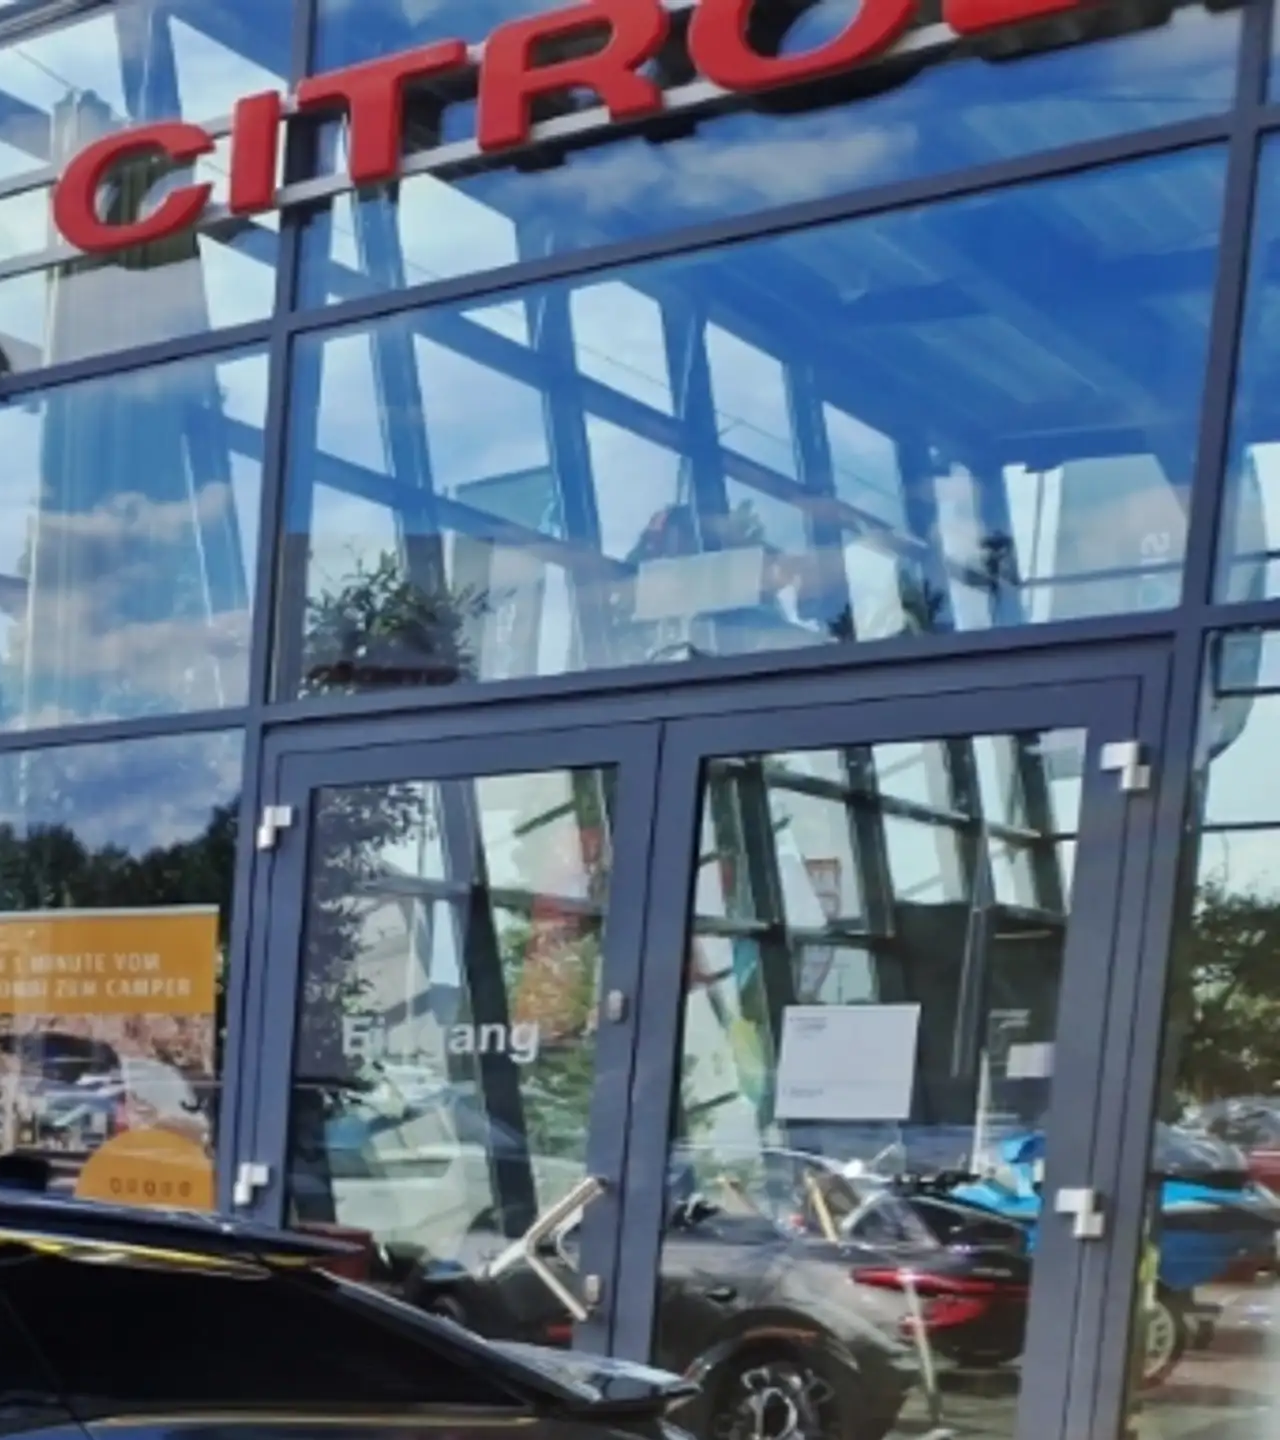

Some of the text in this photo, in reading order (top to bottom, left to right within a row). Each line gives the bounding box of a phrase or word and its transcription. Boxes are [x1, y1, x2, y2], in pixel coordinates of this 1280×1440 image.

[52, 0, 1085, 254] CITRO
[105, 977, 192, 997] CAMPER
[342, 1014, 541, 1064] Eiang
